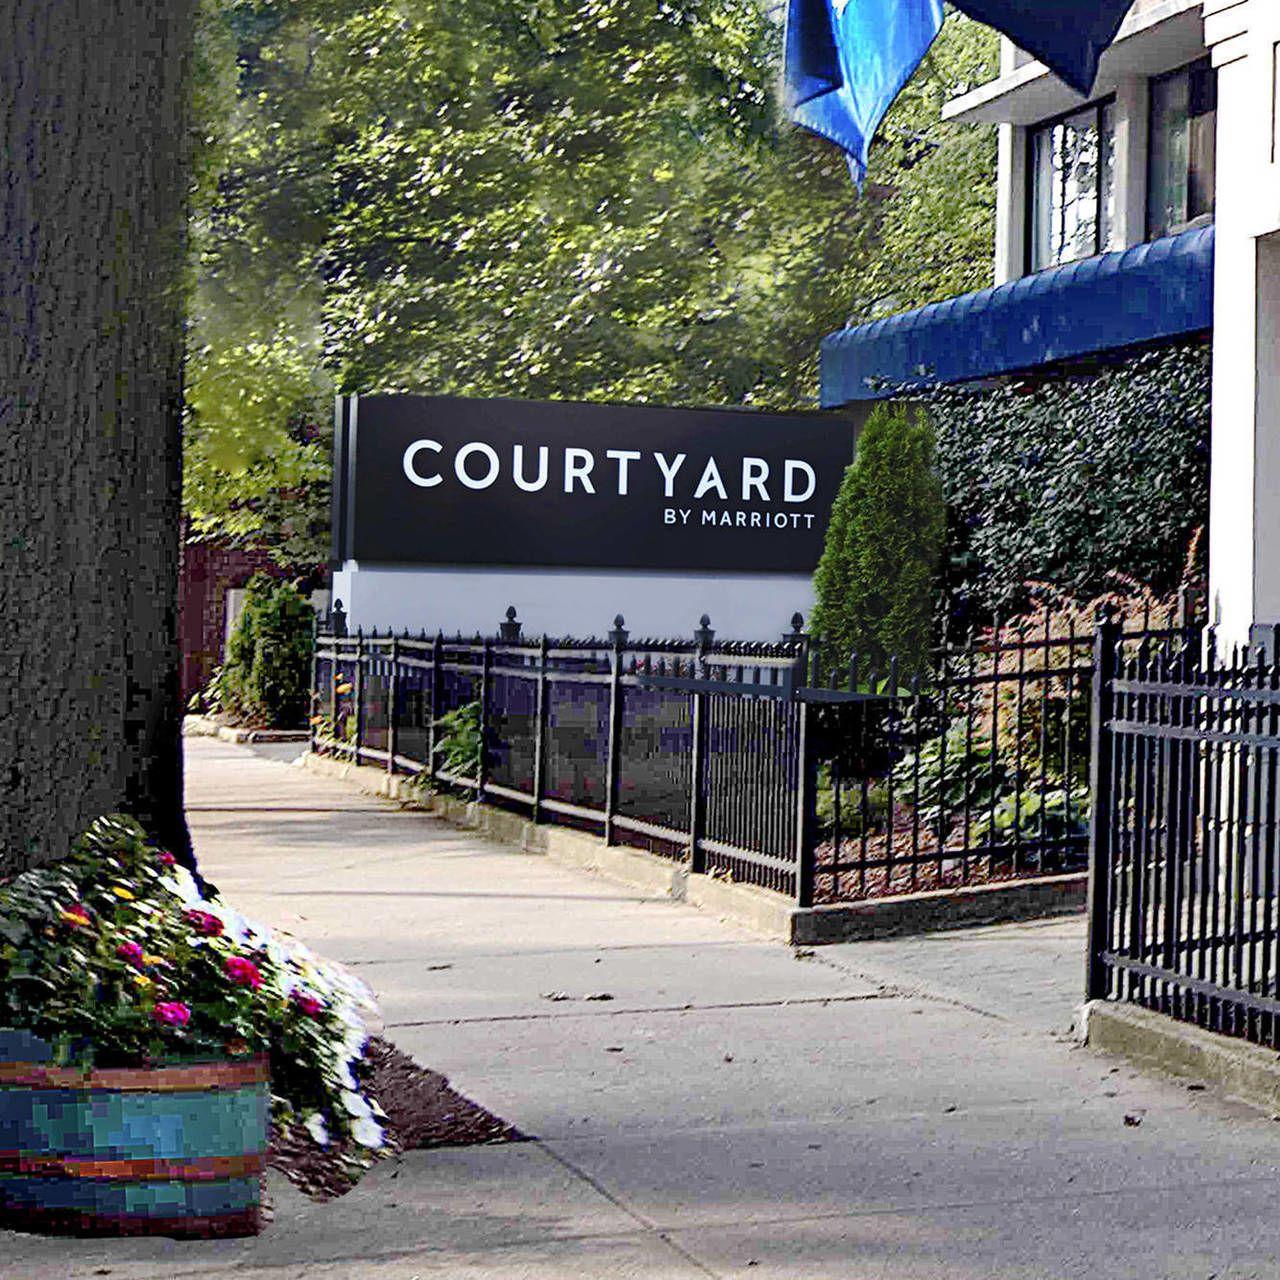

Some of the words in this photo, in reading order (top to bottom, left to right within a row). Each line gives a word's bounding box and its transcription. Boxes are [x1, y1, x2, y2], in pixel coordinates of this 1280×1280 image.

[401, 438, 819, 504] COURTYARD
[663, 508, 691, 526] BY
[701, 510, 817, 530] MARRIOTT
